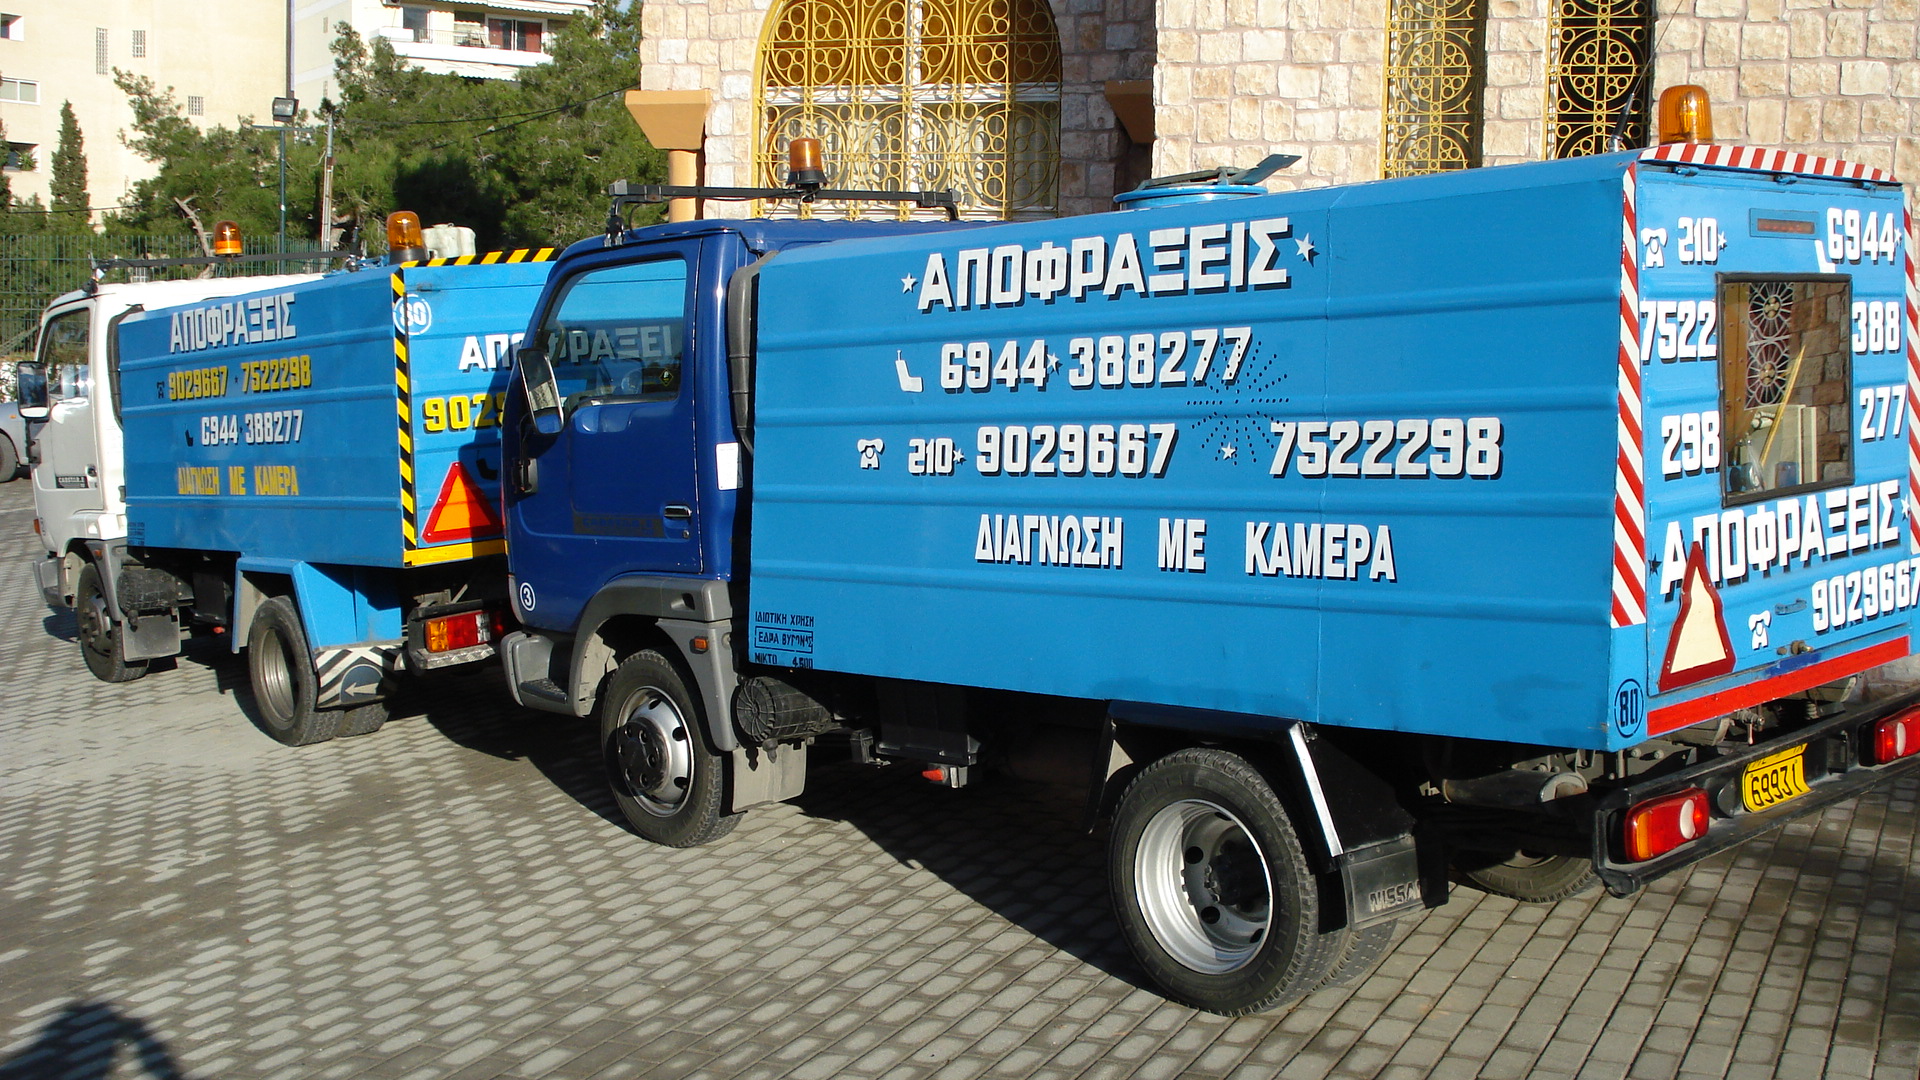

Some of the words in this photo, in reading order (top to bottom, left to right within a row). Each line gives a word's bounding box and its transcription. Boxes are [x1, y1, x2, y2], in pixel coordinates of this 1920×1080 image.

[918, 217, 1291, 311] ΑΠΟΦΡΑΞΕΙΣ
[1677, 216, 1718, 263] 210
[1826, 207, 1895, 262] 6944
[170, 292, 297, 353] ΑΠΟΦΡΑΞΕΙΣ
[1640, 300, 1717, 361] 7522
[1851, 301, 1901, 353] 388
[169, 365, 228, 401] 9029667
[240, 354, 312, 392] 7522298
[940, 339, 1048, 390] 6944
[1068, 326, 1253, 387] 388277
[244, 409, 304, 443] 388277
[1859, 384, 1907, 440] 277
[907, 437, 954, 474] 210
[976, 423, 1177, 475] 9029667
[1269, 416, 1501, 476] 7522298
[1661, 410, 1721, 475] 298
[178, 467, 220, 495] ΔΙΑΓΝΩΣΗ
[229, 466, 247, 495] ΜΕ
[254, 465, 299, 496] ΚΑΜΕΡΑ
[975, 513, 1123, 567] ΔΙΑΓΝΩΣΗ
[1157, 518, 1206, 570] ΜΕ
[1245, 521, 1397, 581] ΚΑΜΕΡΑ
[1659, 479, 1900, 595] ΑΠΟΦΡΑΞΕΙΣ
[1811, 556, 1920, 633] 9029667
